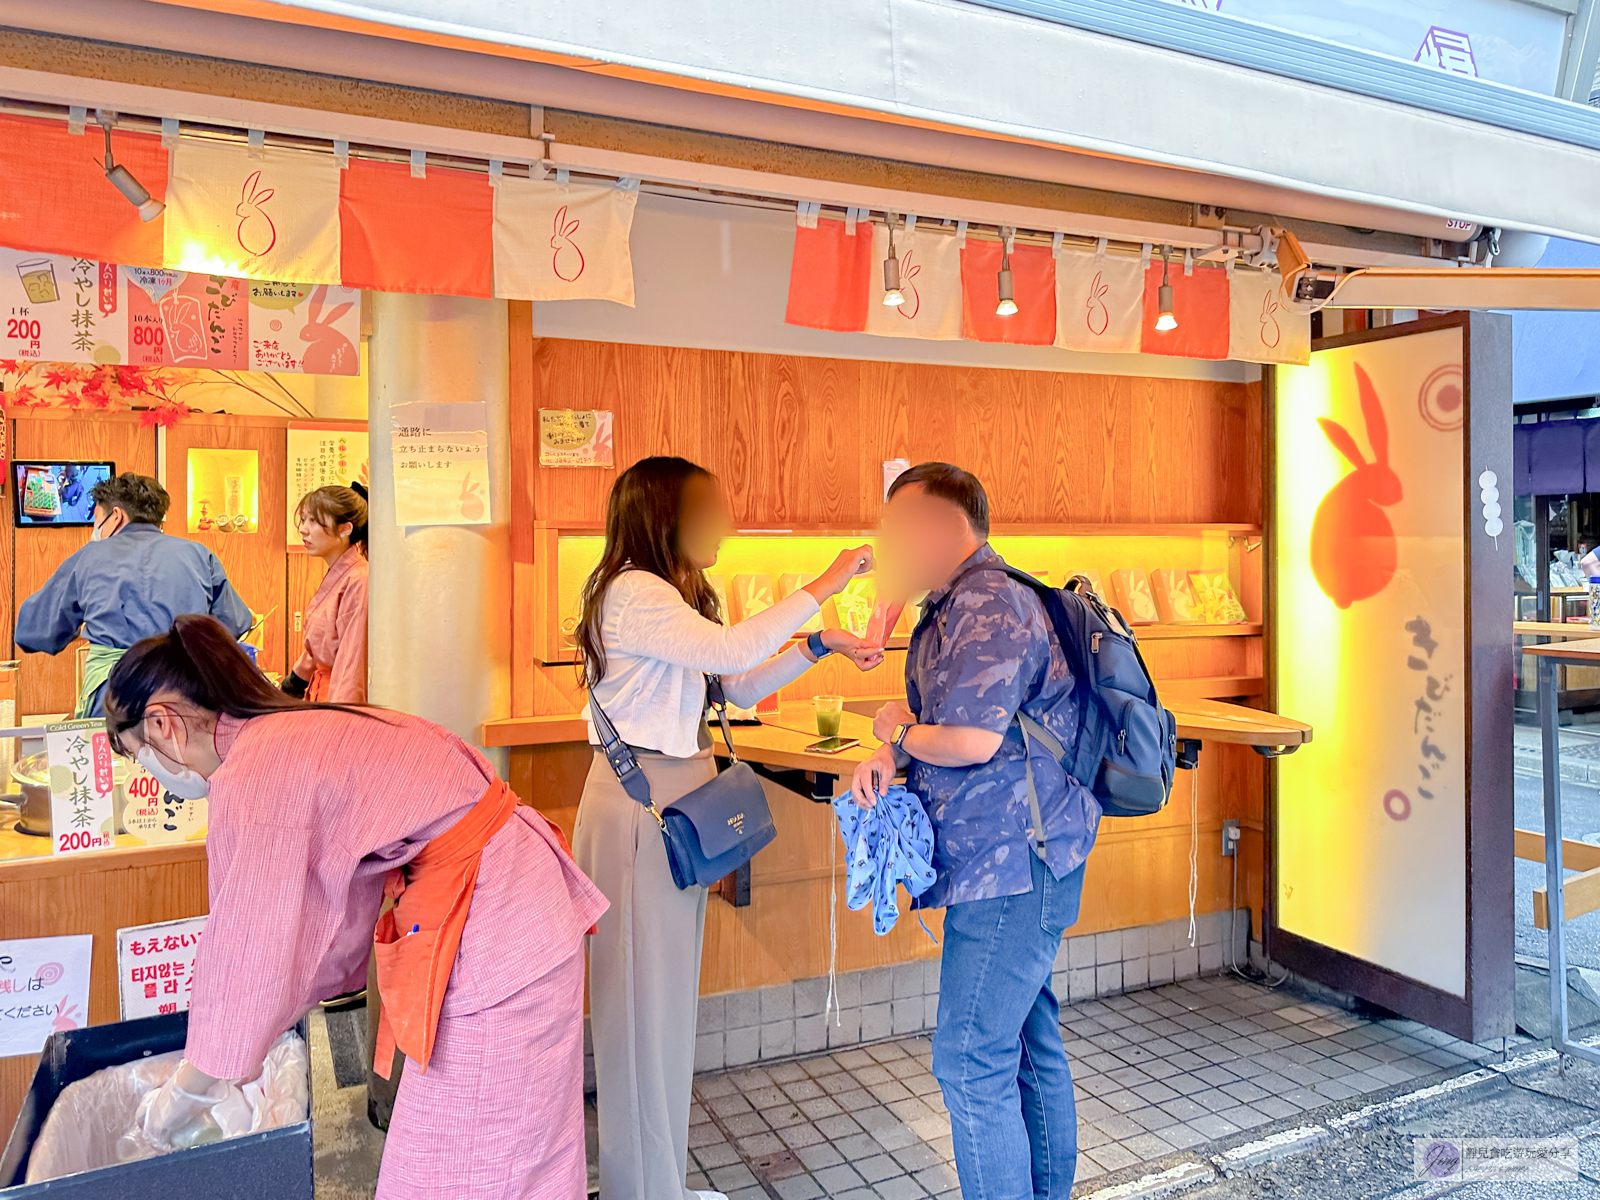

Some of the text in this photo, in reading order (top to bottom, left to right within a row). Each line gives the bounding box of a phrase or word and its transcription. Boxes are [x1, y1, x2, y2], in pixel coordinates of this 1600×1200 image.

[1447, 218, 1471, 230] STOP
[71, 257, 96, 352] 冷やし抹茶
[7, 318, 41, 340] 200
[133, 325, 164, 346] 800
[30, 340, 40, 349] 円
[398, 426, 432, 438] 通路に
[399, 445, 480, 454] 立ち止まらないよう
[400, 461, 452, 469] お願いします
[49, 724, 67, 732] Cold
[67, 722, 90, 730] Green
[65, 735, 95, 828] 冷やし抹茶
[147, 797, 158, 807] 円
[130, 931, 203, 956] もえない
[0, 1003, 59, 1020] ください
